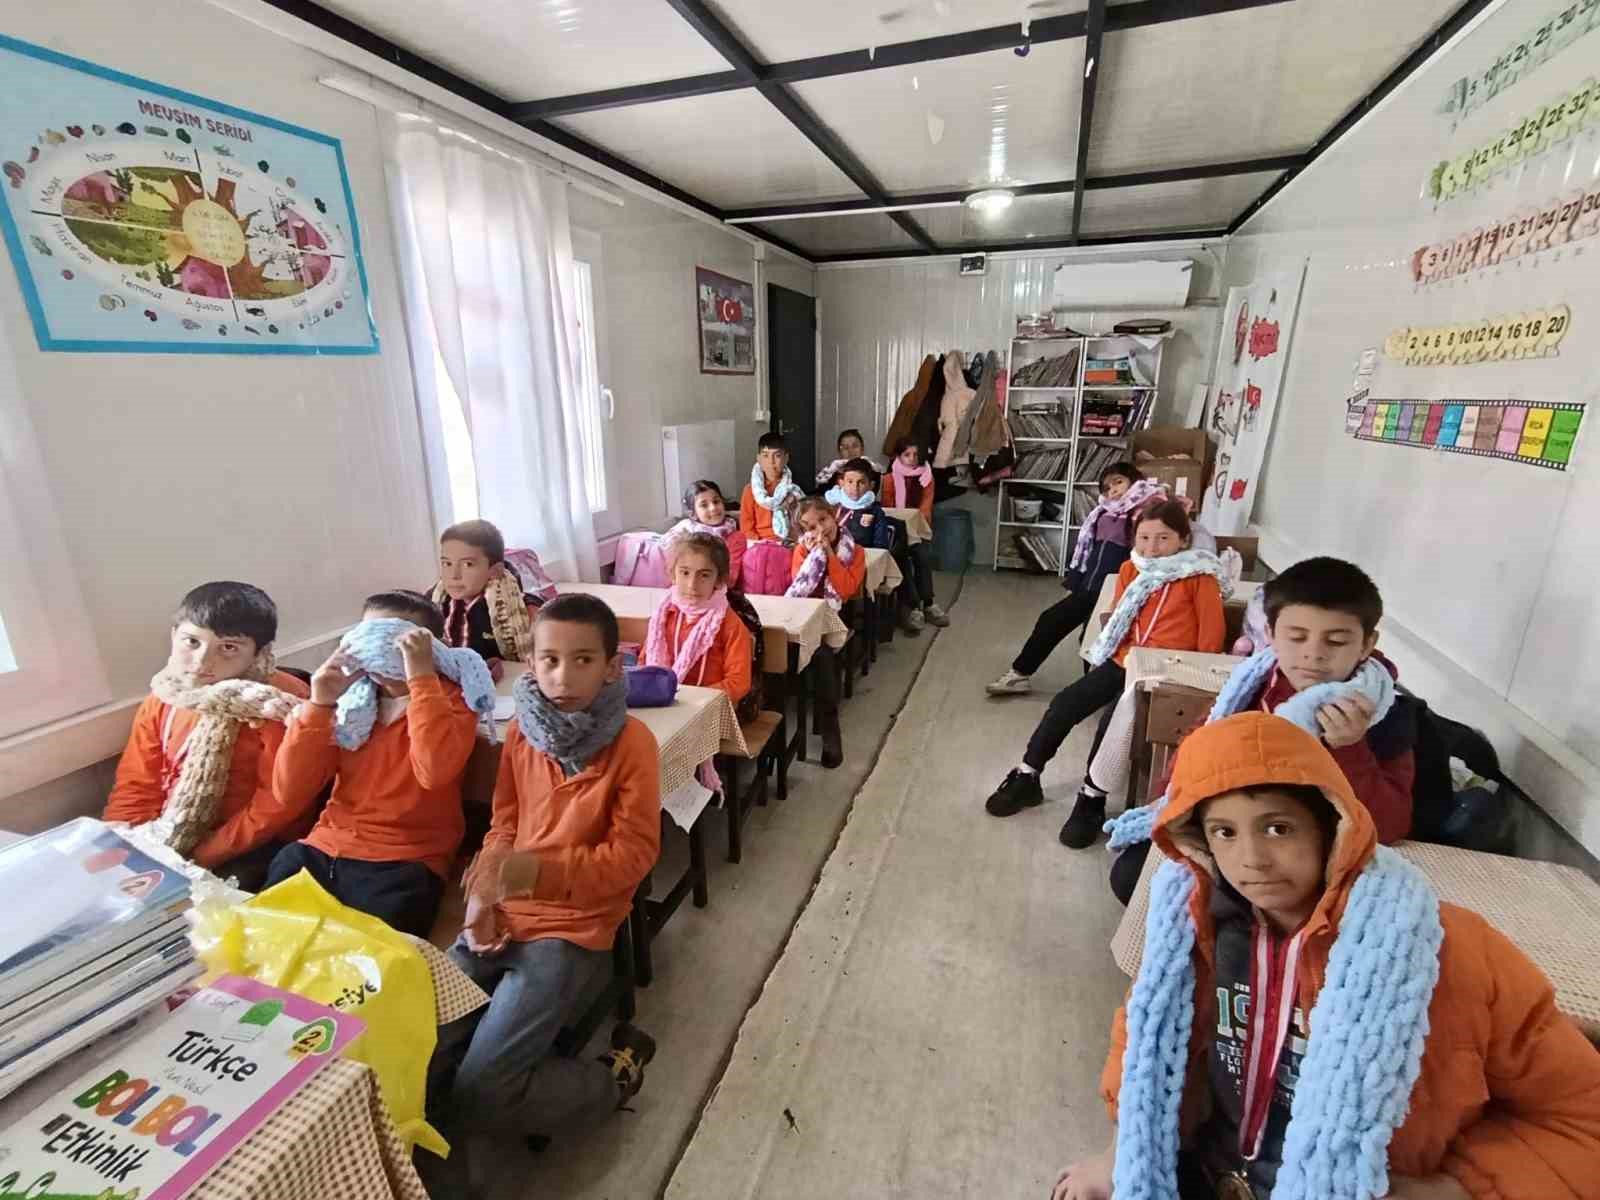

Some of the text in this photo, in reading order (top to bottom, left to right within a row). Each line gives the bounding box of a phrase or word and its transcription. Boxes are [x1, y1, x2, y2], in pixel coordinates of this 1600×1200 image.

[1429, 253, 1438, 267] 3
[1518, 216, 1535, 236] 21
[1538, 210, 1557, 230] 24
[1409, 336, 1418, 350] 2
[1422, 335, 1430, 348] 4
[1459, 330, 1472, 344] 10
[1474, 327, 1486, 343] 12
[1488, 325, 1503, 341] 14
[1507, 322, 1523, 340] 16
[1525, 319, 1543, 337] 18
[1546, 315, 1566, 335] 20
[167, 1030, 258, 1082] Türkçe
[41, 1121, 150, 1183] Etkinlik
